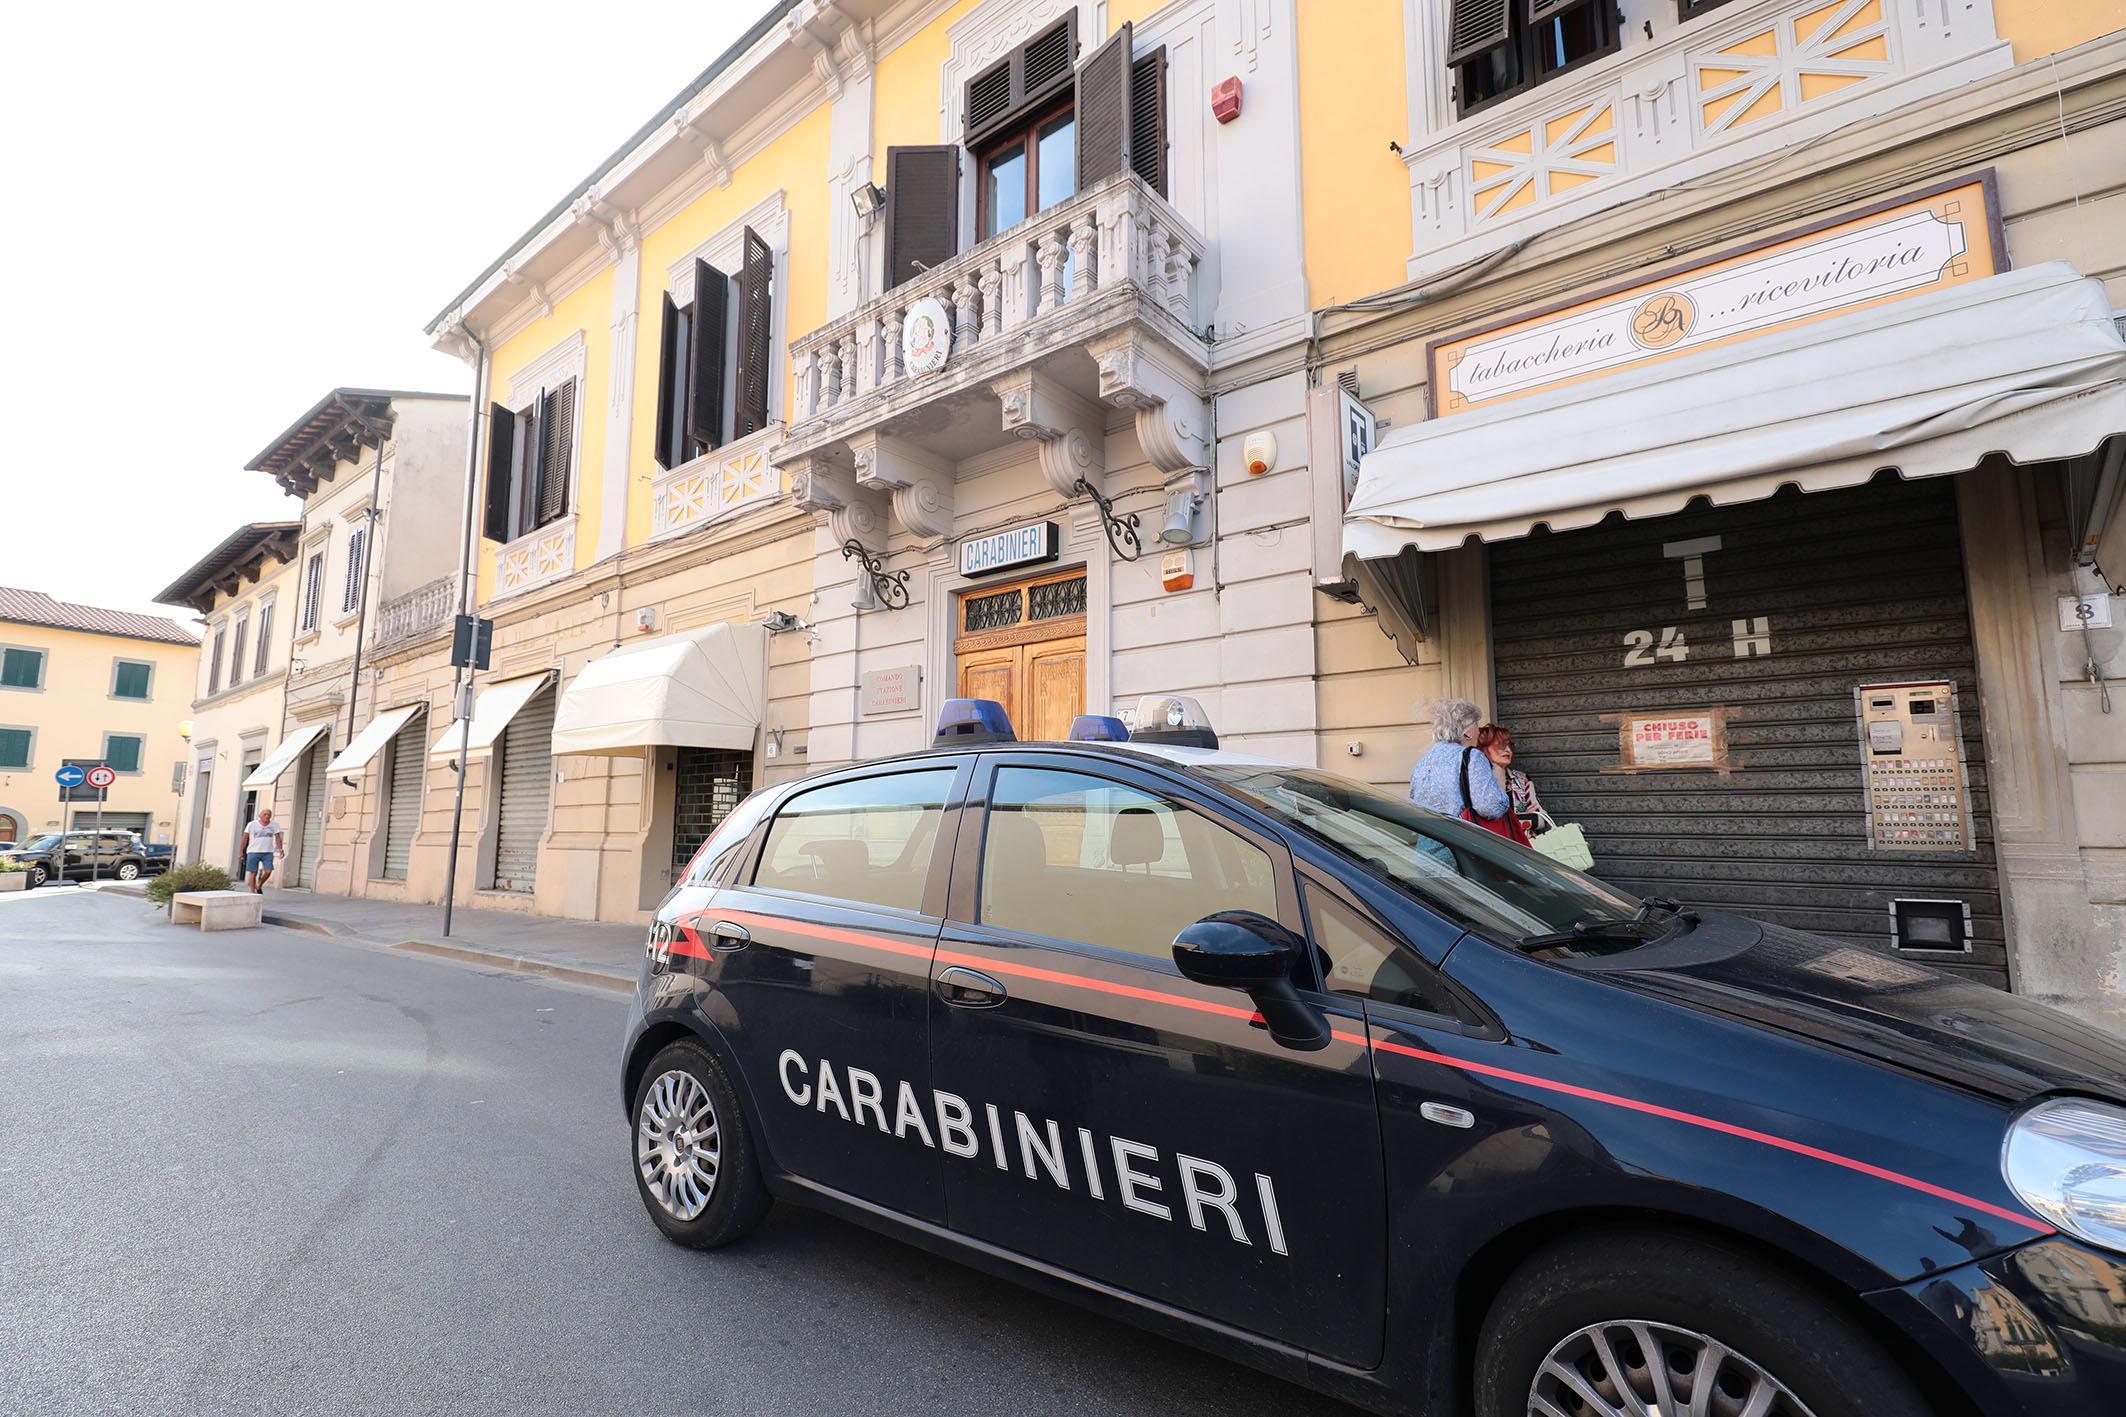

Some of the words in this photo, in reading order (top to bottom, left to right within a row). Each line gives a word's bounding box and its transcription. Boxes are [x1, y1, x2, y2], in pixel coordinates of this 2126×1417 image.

[1468, 328, 1617, 385] tabaccheria
[966, 526, 1042, 571] CARABINIERI
[1663, 535, 1722, 610] T
[2075, 603, 2095, 620] 8
[1624, 627, 1690, 668] 24
[1732, 616, 1771, 657] H
[1635, 732, 1662, 742] PER
[1667, 730, 1708, 740] FERIE
[1643, 720, 1698, 732] CHIUSO
[778, 1048, 1288, 1257] CARABINIERI
